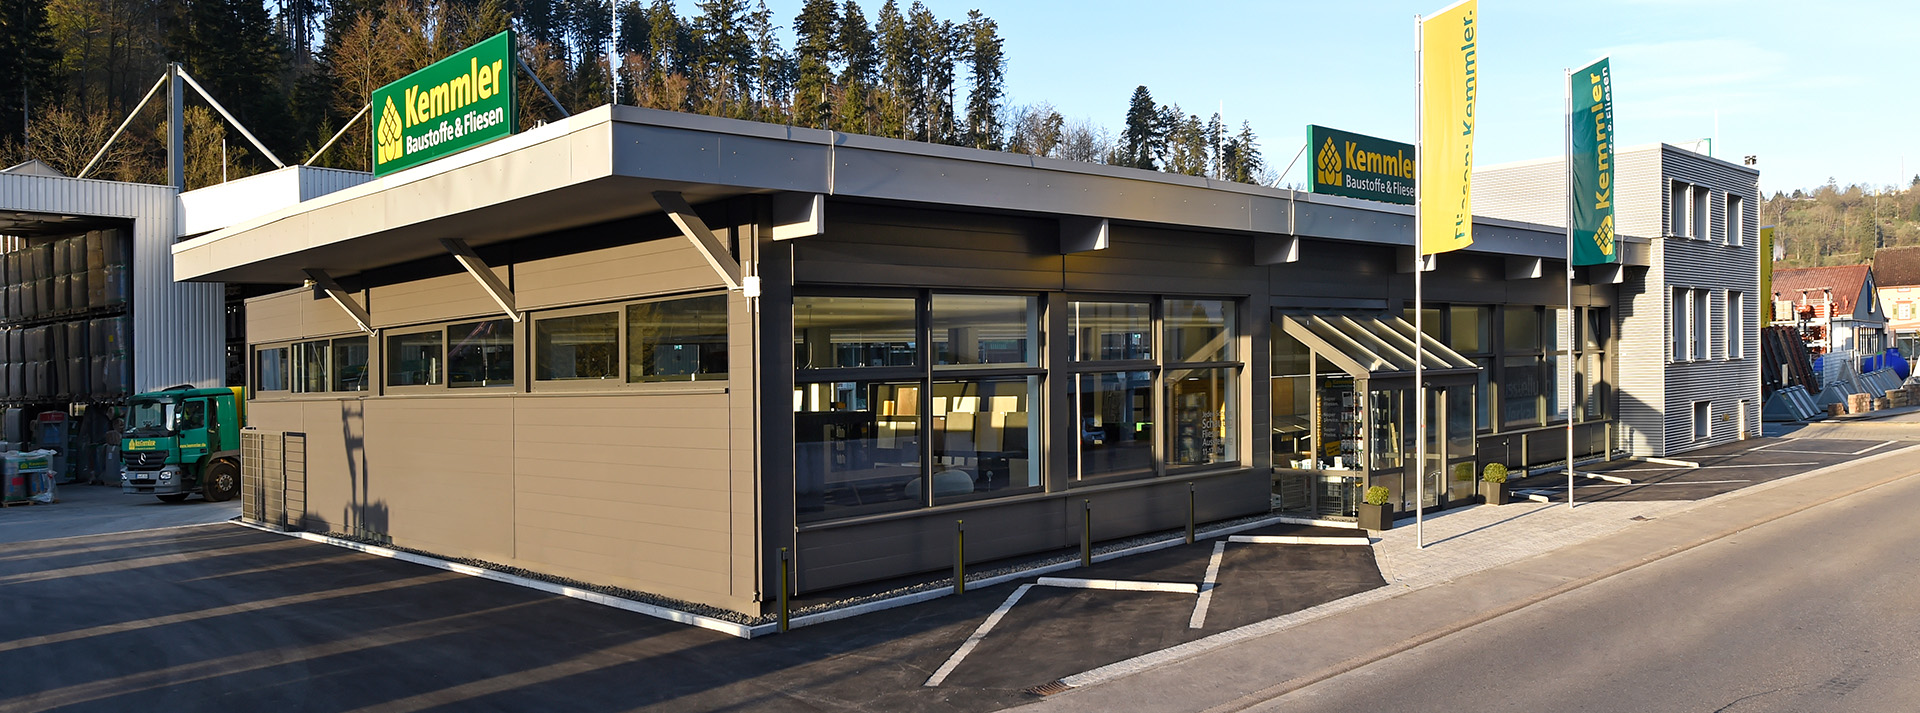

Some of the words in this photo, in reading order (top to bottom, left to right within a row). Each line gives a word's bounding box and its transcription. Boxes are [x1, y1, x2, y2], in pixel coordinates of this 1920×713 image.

[405, 57, 503, 128] Kemmler
[1461, 10, 1476, 136] Kemmler.
[406, 120, 453, 155] Baustoffe
[454, 117, 463, 137] &
[464, 106, 504, 136] Fliesen
[1591, 72, 1610, 210] Kemmler
[1346, 174, 1386, 193] Baustoffe
[1386, 180, 1393, 194] &
[1393, 182, 1416, 197] Fliese
